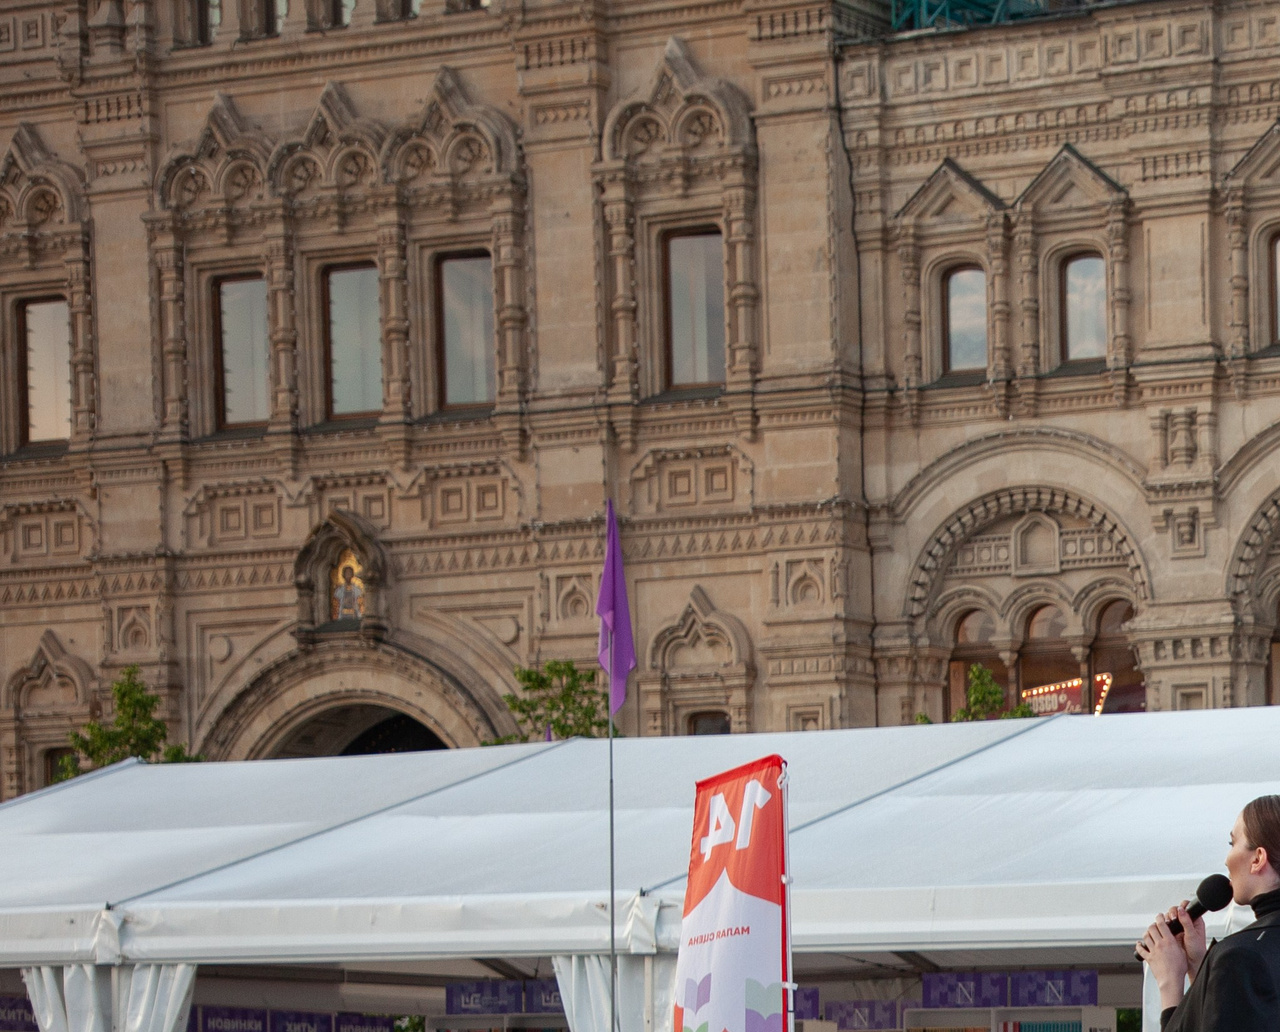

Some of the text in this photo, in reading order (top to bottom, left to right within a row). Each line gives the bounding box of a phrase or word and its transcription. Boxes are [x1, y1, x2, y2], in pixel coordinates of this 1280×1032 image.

[958, 981, 975, 1003] N
[1047, 980, 1064, 1003] N
[207, 1017, 262, 1032] НОВИНКИ
